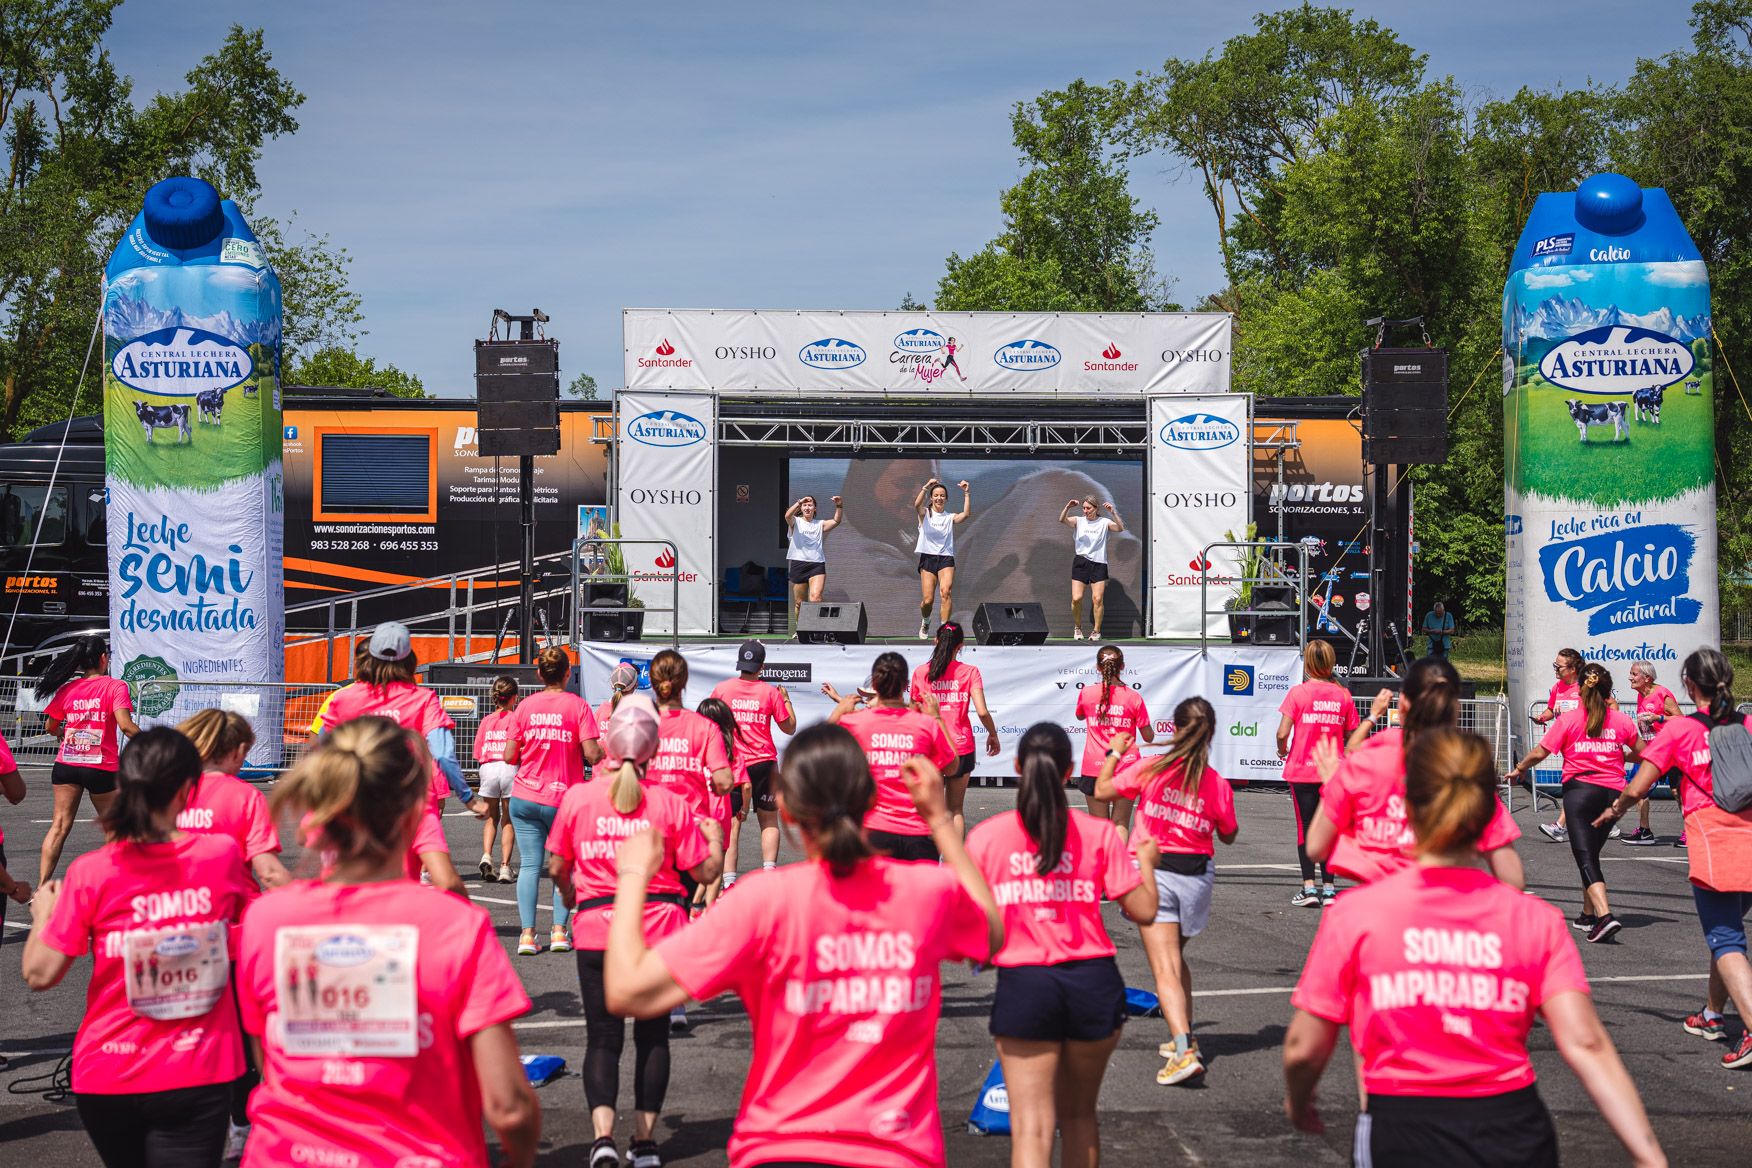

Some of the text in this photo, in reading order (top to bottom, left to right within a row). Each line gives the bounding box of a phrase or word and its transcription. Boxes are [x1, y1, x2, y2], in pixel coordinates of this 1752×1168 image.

[226, 244, 249, 253] CERO
[1536, 237, 1556, 252] PLS
[1590, 246, 1630, 262] Calcio
[898, 338, 942, 347] ASTURIANA
[715, 346, 776, 360] OYSHO
[804, 350, 862, 362] ASTURIANA
[890, 350, 932, 364] Carrera
[1000, 351, 1056, 363] ASTURIANA
[1161, 350, 1222, 363] OYSHO
[1627, 348, 1678, 356] LECHERA
[120, 352, 243, 379] ASTURIANA
[500, 356, 528, 364] portos
[638, 358, 692, 368] Santander
[1084, 362, 1138, 372] Santander
[1550, 352, 1683, 379] ASTURIANA
[914, 364, 946, 383] Mujer
[634, 422, 700, 438] ASTURIANA
[1166, 427, 1234, 442] ASTURIANA
[464, 466, 488, 474] Rampa
[450, 486, 477, 494] Soporte
[630, 488, 701, 506] OYSHO
[1268, 482, 1364, 506] portos
[1164, 492, 1236, 508] OYSHO
[1352, 506, 1364, 514] SL.
[122, 512, 192, 554] Leche
[314, 523, 435, 536] www.sonorizacionesportos.com
[1548, 512, 1642, 542] Leche rica en
[310, 540, 438, 550] 983 528 268 696 455 353
[119, 544, 254, 600] semi
[1554, 540, 1678, 601] Calcio
[6, 576, 58, 588] portos
[120, 596, 260, 634] desnatada
[1610, 596, 1676, 624] natural
[182, 659, 246, 674] INGREDIENTES:
[932, 680, 959, 690] SOMOS
[1258, 673, 1289, 682] Correos
[1258, 682, 1289, 692] Express
[732, 699, 760, 710] SOMOS
[1312, 700, 1342, 712] SOMOS
[530, 713, 562, 726] SOMOS
[1230, 721, 1258, 736] dial
[658, 738, 688, 753] OMOS
[872, 733, 914, 749] SOMOS
[1240, 758, 1250, 766] EL
[1144, 800, 1210, 832] IMPARABLES
[993, 878, 1095, 906] IMPARABLES
[131, 886, 212, 923] SOMOS
[816, 931, 916, 973] SOMOS
[1403, 927, 1503, 969] SOMOS
[161, 966, 198, 986] 016
[321, 986, 371, 1008] 016
[1370, 969, 1530, 1013] IMPARABLES
